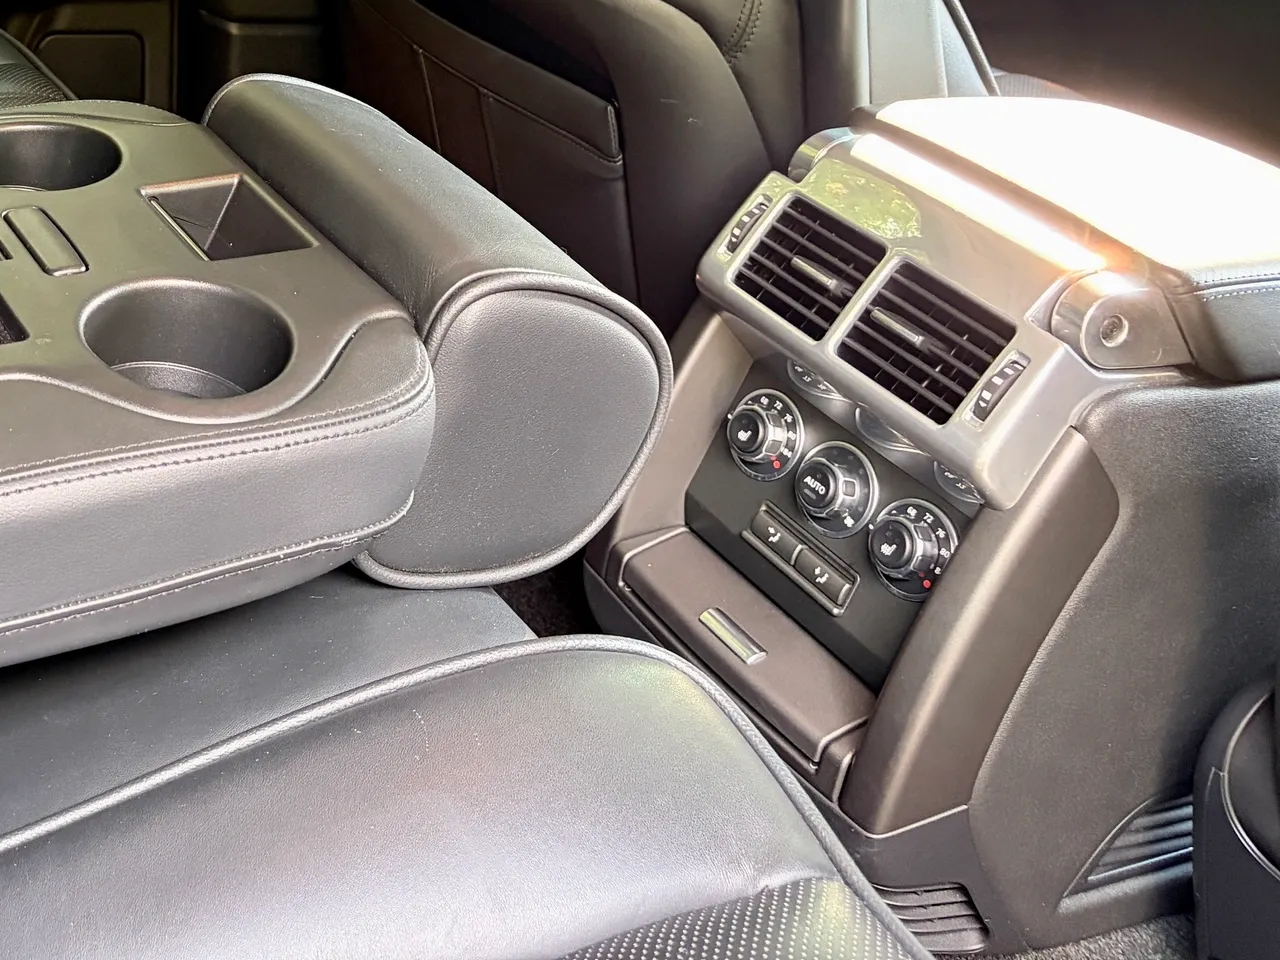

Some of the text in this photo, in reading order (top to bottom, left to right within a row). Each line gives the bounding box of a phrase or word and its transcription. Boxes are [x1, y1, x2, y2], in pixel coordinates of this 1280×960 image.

[773, 400, 784, 410] 72
[783, 413, 793, 423] 76
[803, 475, 826, 495] AUTO
[906, 506, 918, 517] 68
[923, 512, 935, 523] 72
[935, 527, 946, 538] 76
[939, 547, 951, 559] 80
